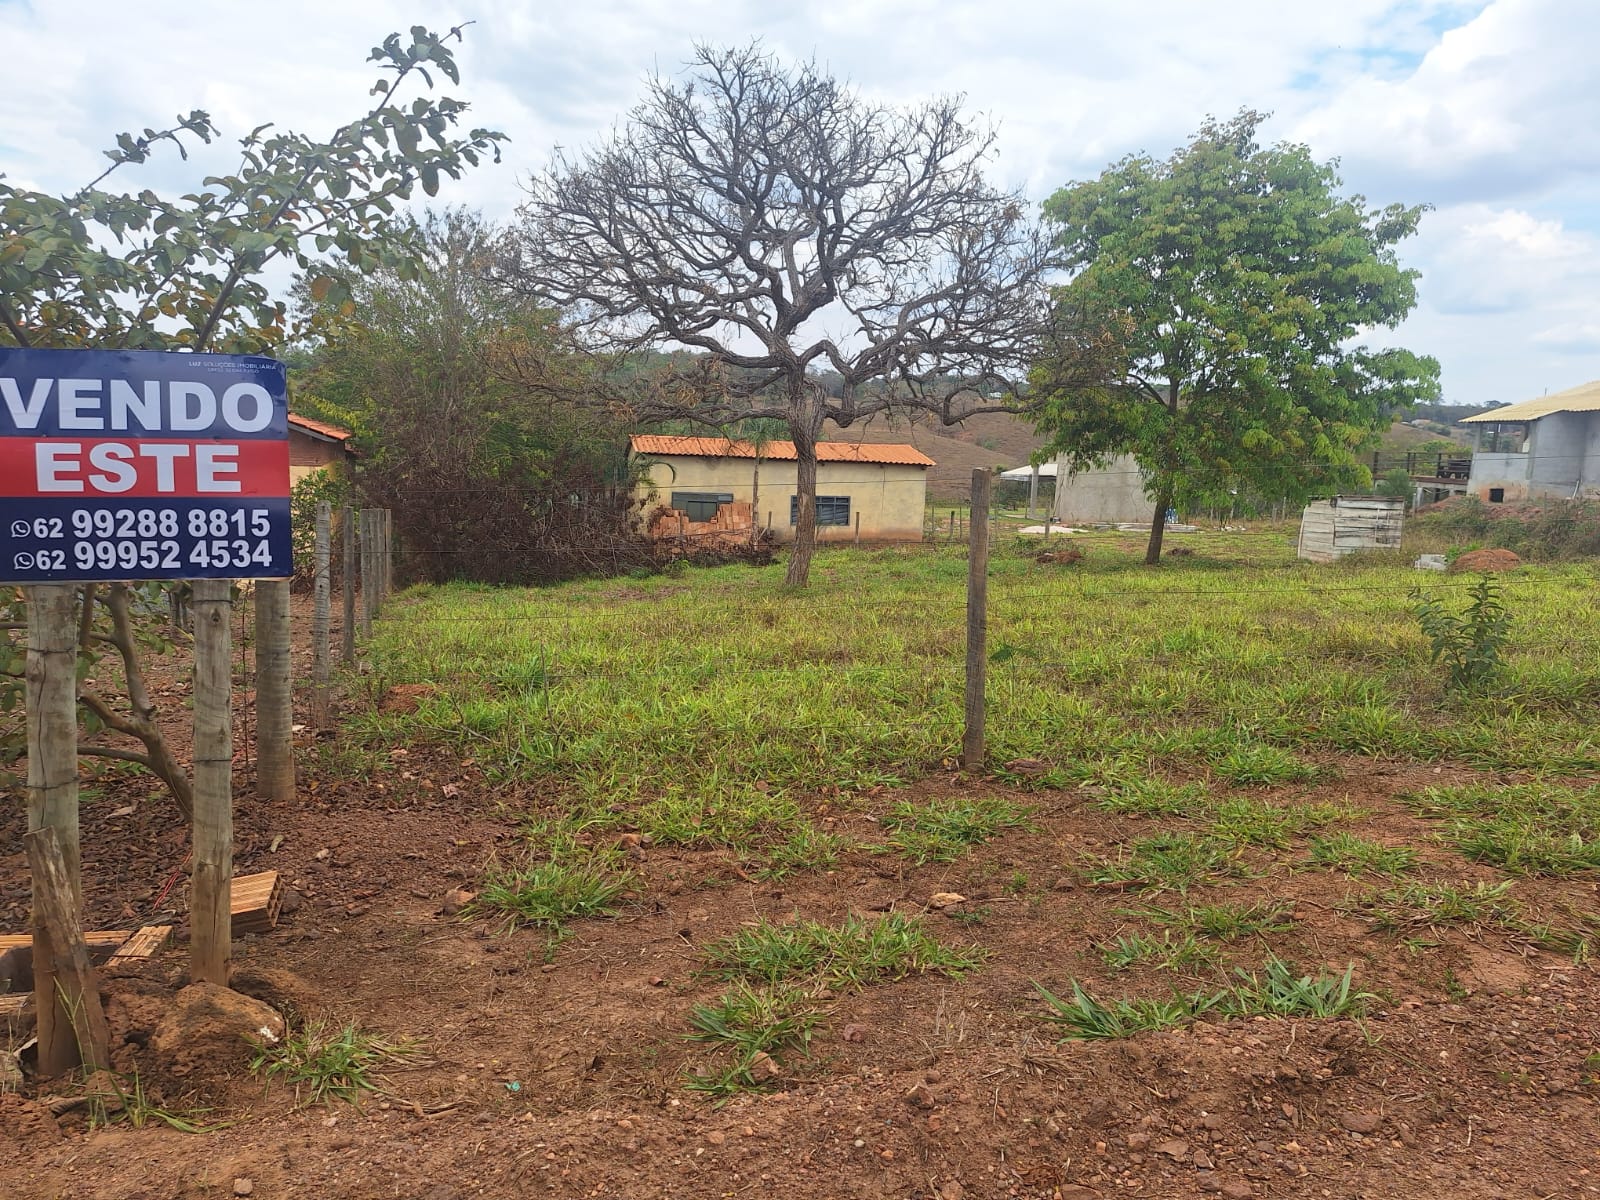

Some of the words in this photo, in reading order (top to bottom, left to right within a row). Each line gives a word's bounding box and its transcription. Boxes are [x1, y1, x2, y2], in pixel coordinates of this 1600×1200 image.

[0, 378, 274, 433] VENDO
[35, 442, 242, 493] ESTE
[33, 518, 64, 538] 62
[71, 509, 179, 538] 99288
[188, 508, 271, 537] 8815
[36, 550, 67, 570] 62
[74, 541, 181, 569] 99952
[189, 539, 272, 568] 4534
